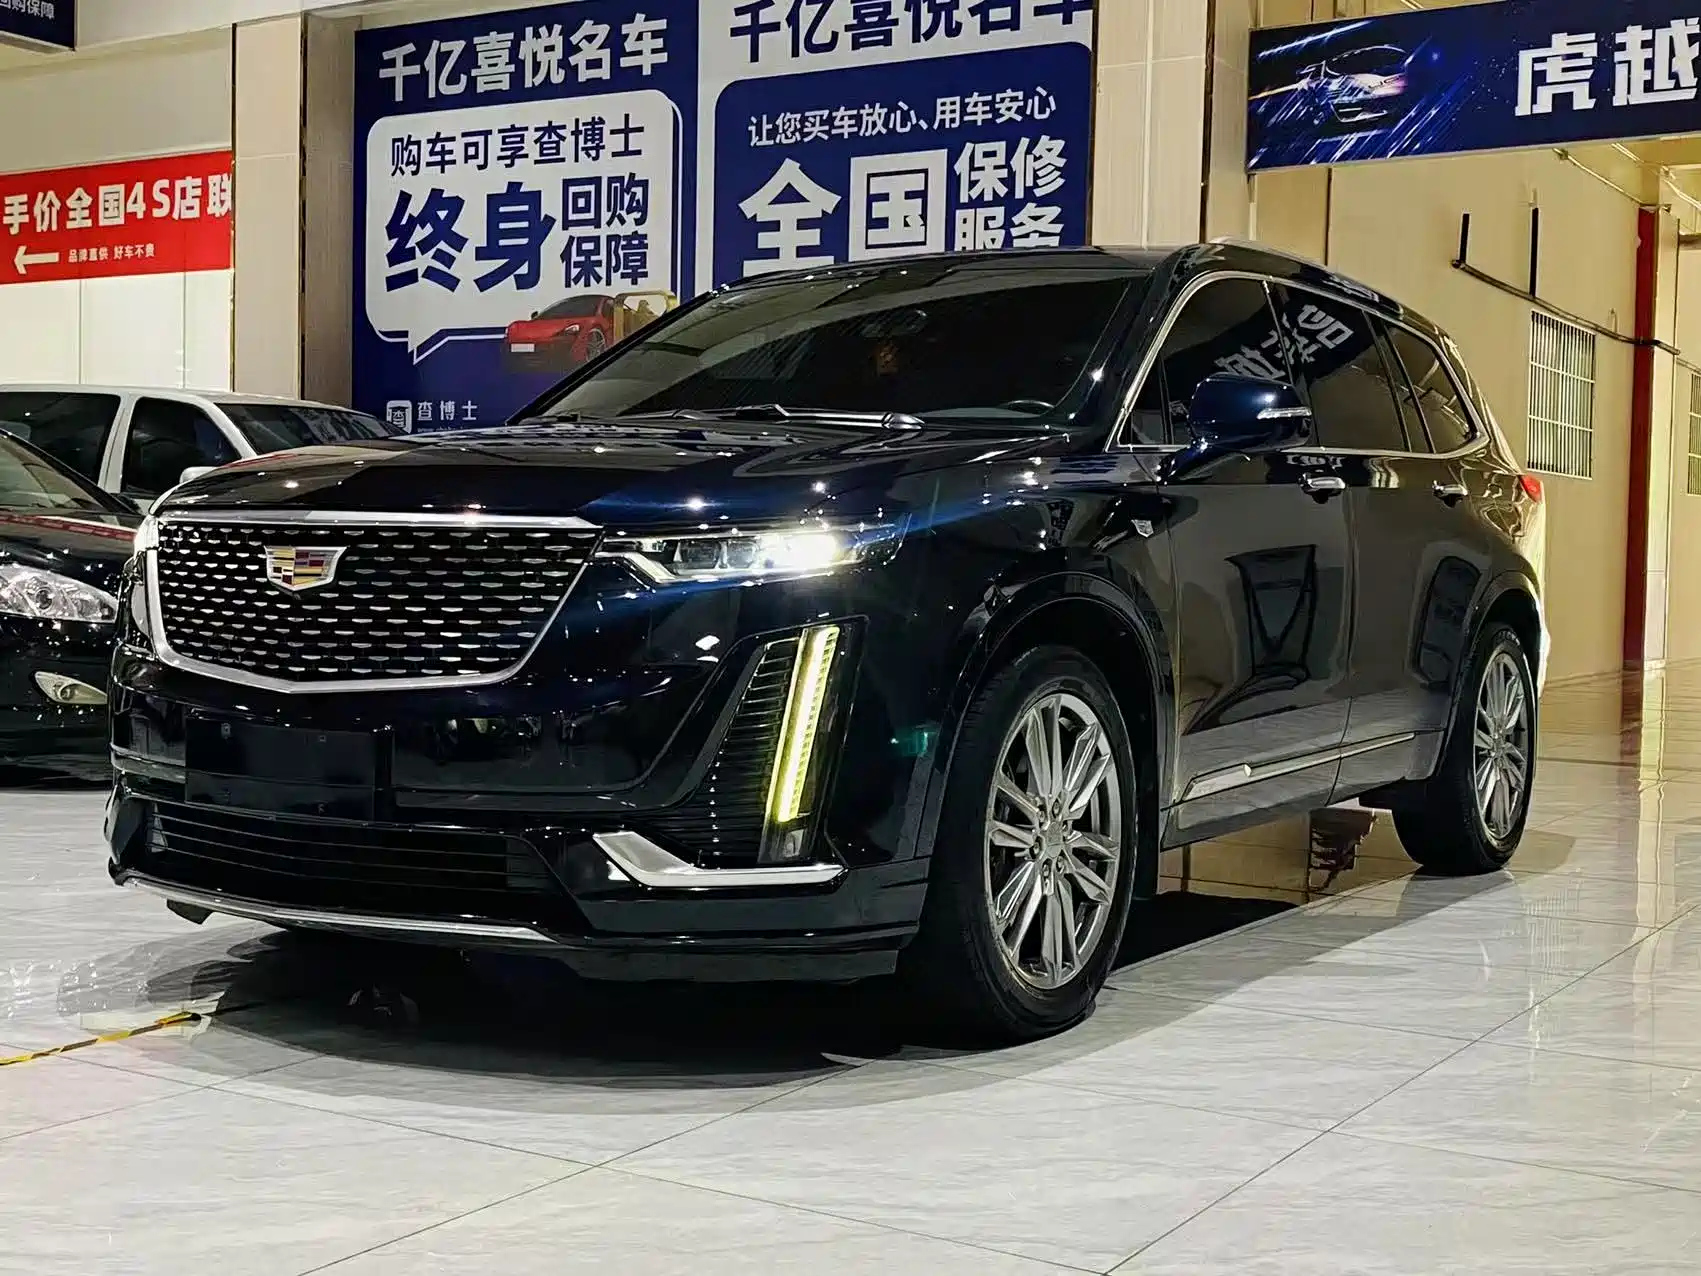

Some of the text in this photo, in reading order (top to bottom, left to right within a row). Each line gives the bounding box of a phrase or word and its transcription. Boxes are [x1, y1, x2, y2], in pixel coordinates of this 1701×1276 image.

[378, 13, 669, 102] 千亿喜悦名车
[1515, 17, 1701, 116] 虎越
[390, 113, 646, 177] 购车可享查博士
[747, 86, 1057, 147] 让您买车放心、用车安心
[953, 135, 1067, 203] 保修
[2, 173, 232, 235] 手价全国4S店联
[561, 172, 650, 231] 回购
[738, 148, 948, 278] 全国
[954, 202, 1064, 252] 服务
[385, 181, 557, 293] 终身
[559, 231, 650, 288] 保障
[417, 400, 478, 421] 查博士
